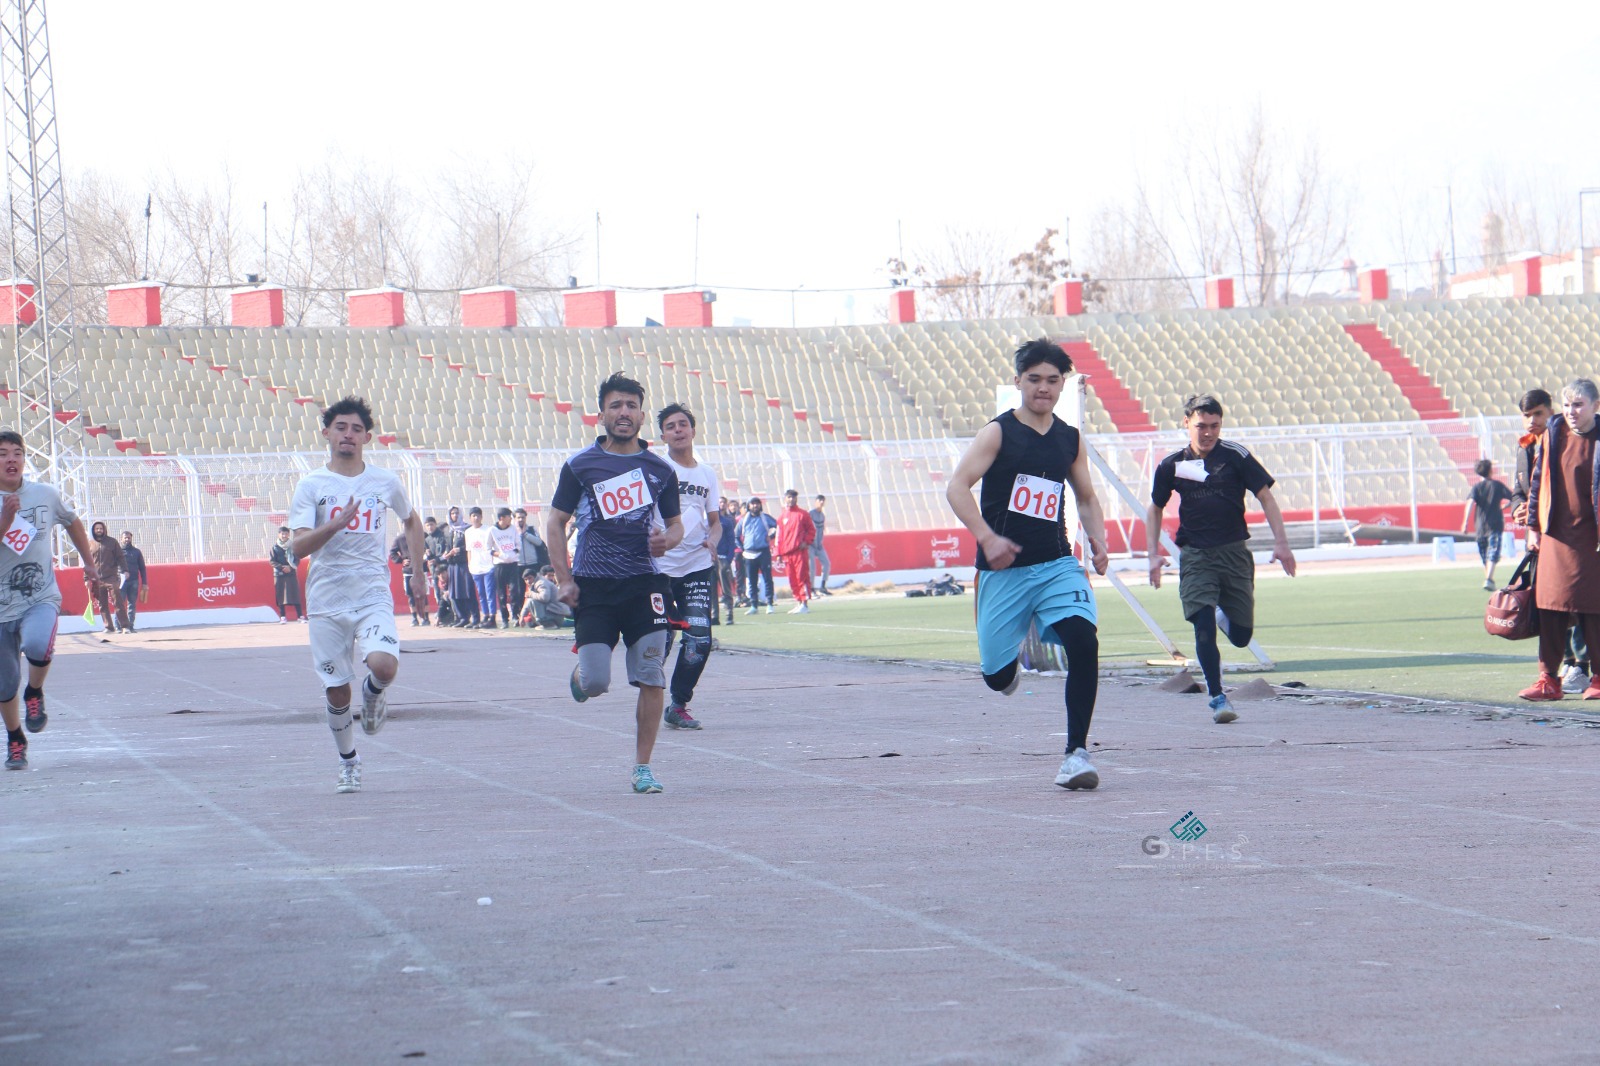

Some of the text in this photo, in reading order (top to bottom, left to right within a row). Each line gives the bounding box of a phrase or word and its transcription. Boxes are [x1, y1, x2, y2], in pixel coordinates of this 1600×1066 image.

[602, 480, 644, 516] 087
[1013, 486, 1058, 519] 018
[931, 549, 960, 559] ROSHAN
[197, 567, 235, 586] روشن
[197, 586, 236, 602] ROSHAN
[1072, 589, 1090, 603] 11
[1492, 616, 1508, 627] NIKE
[366, 624, 380, 638] 77
